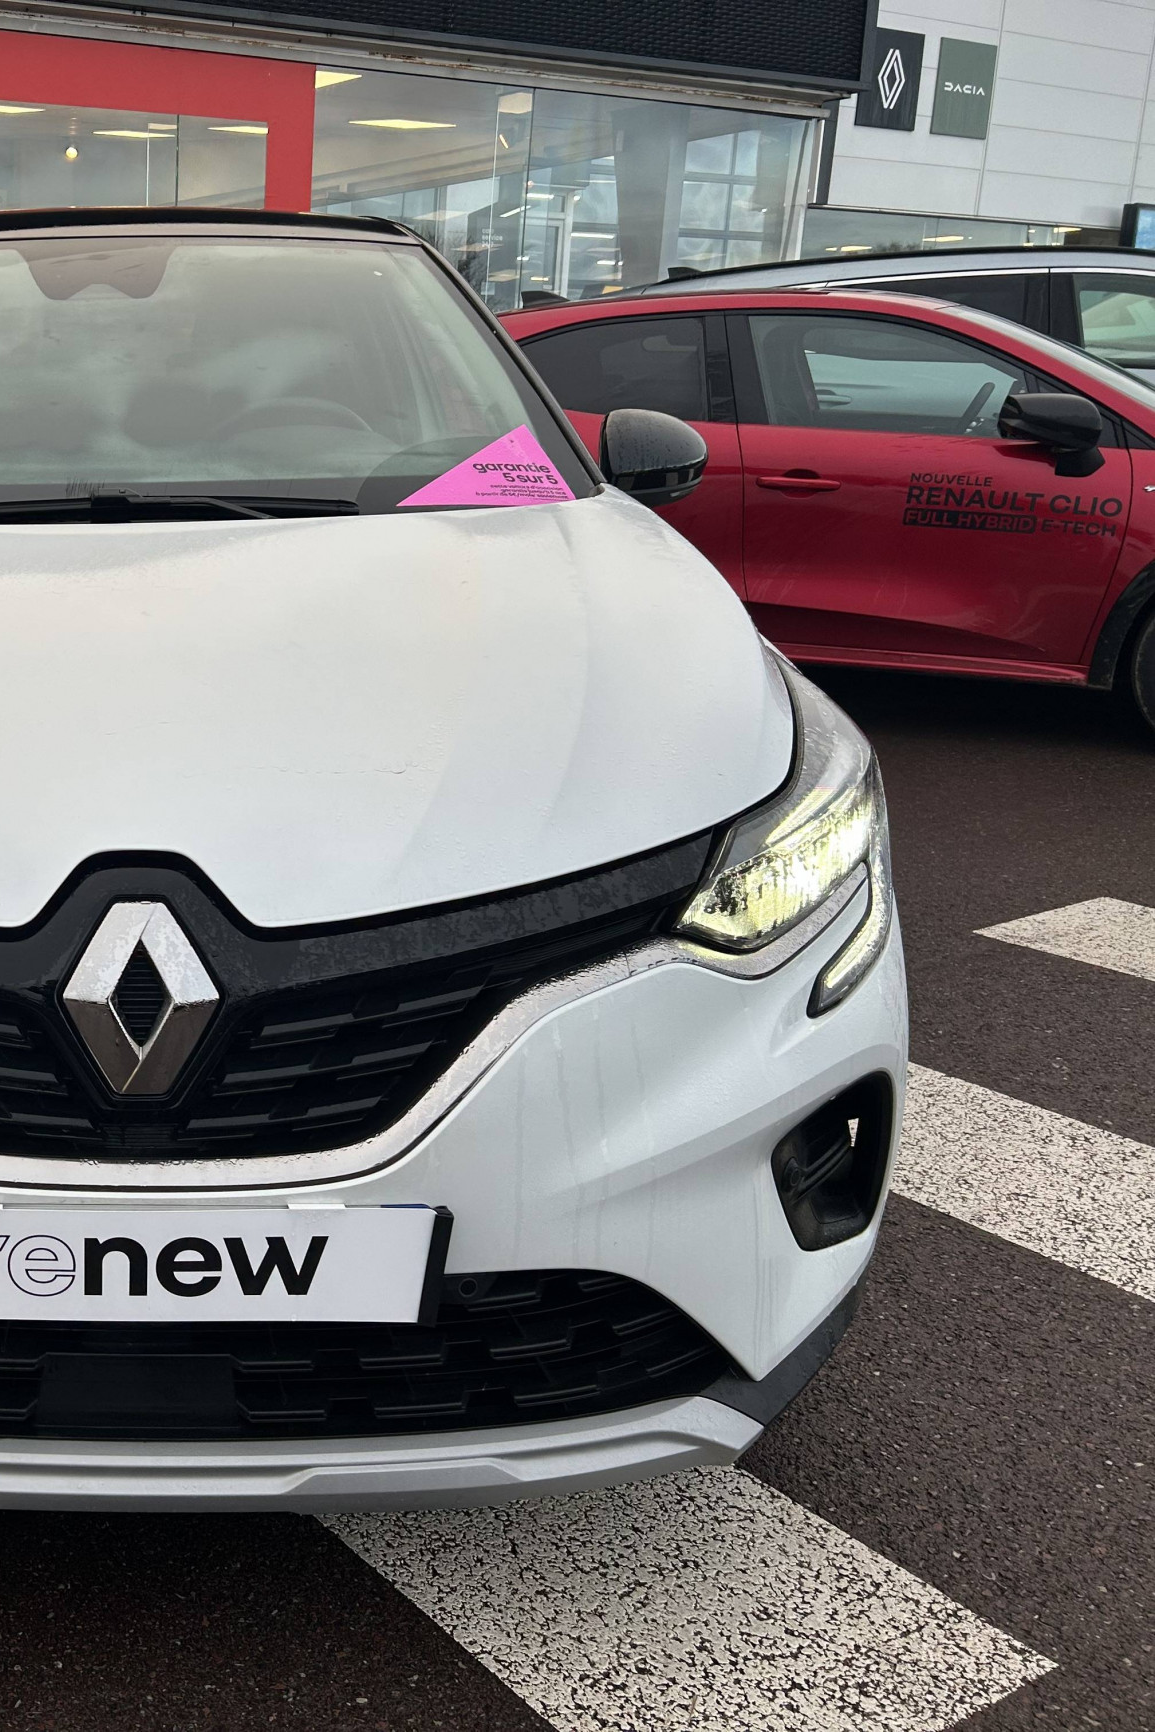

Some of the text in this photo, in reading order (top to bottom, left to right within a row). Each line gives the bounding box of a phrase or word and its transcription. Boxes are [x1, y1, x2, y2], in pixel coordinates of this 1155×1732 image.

[944, 81, 985, 96] DACIA
[472, 462, 551, 474] garantie
[503, 473, 559, 485] 5 sur 5
[910, 472, 993, 487] NOUVELLE
[906, 486, 1123, 518] RENAULT CLIO
[905, 509, 1117, 537] FULL HYBRID E-TECH
